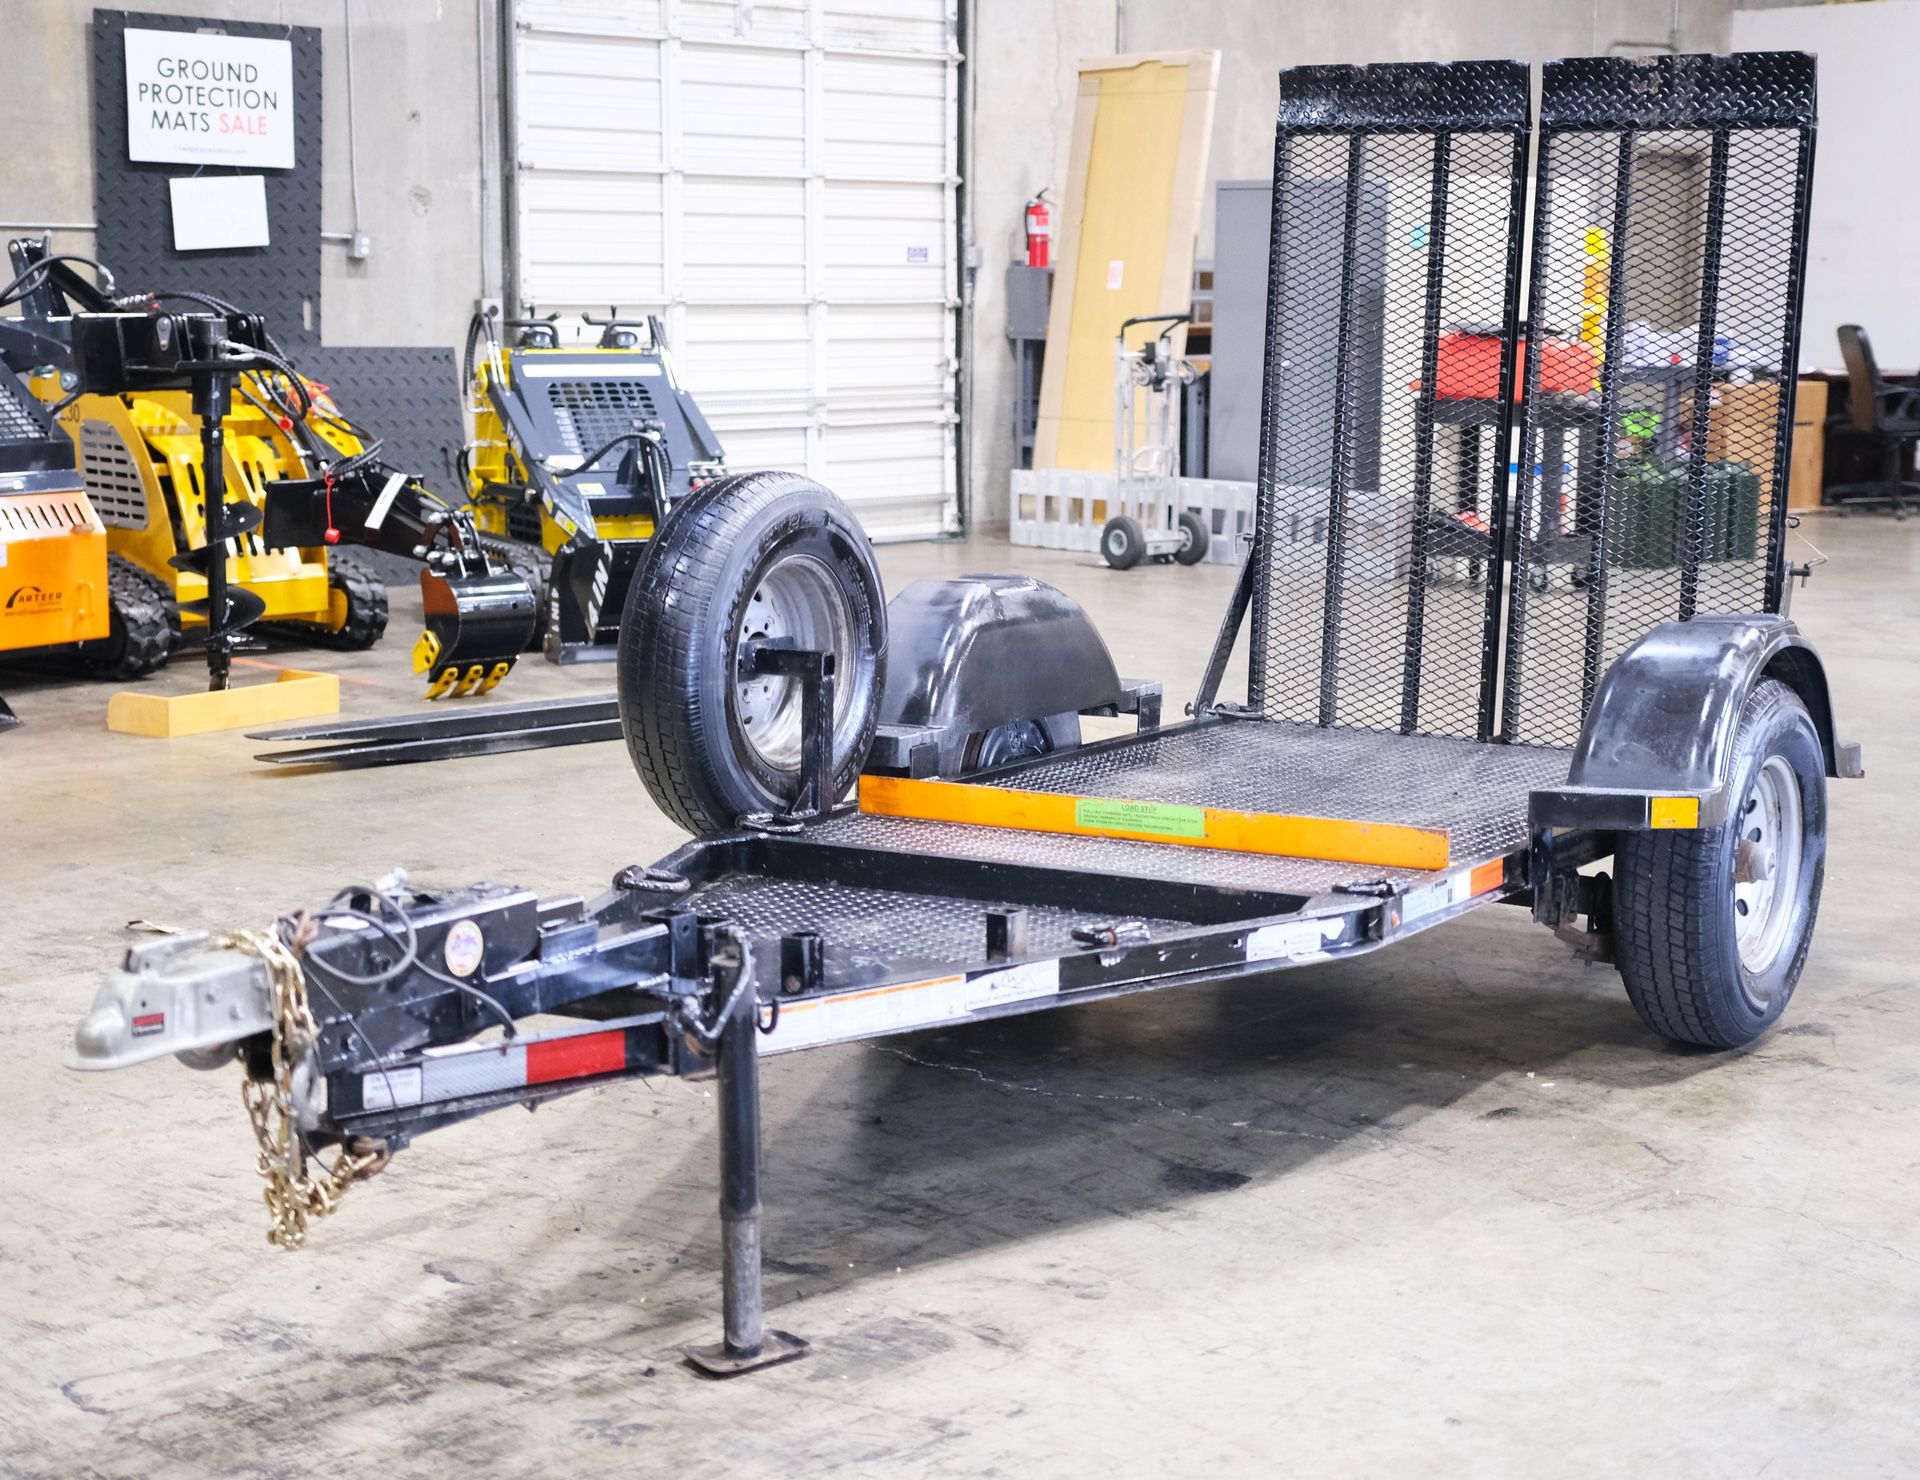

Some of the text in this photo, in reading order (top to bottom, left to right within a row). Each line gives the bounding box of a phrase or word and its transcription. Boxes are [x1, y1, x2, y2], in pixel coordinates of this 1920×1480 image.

[157, 57, 258, 83] GROUND
[138, 82, 278, 110] PROTECTION
[151, 109, 268, 135] MATS SALE
[1121, 803, 1140, 812] LOAD
